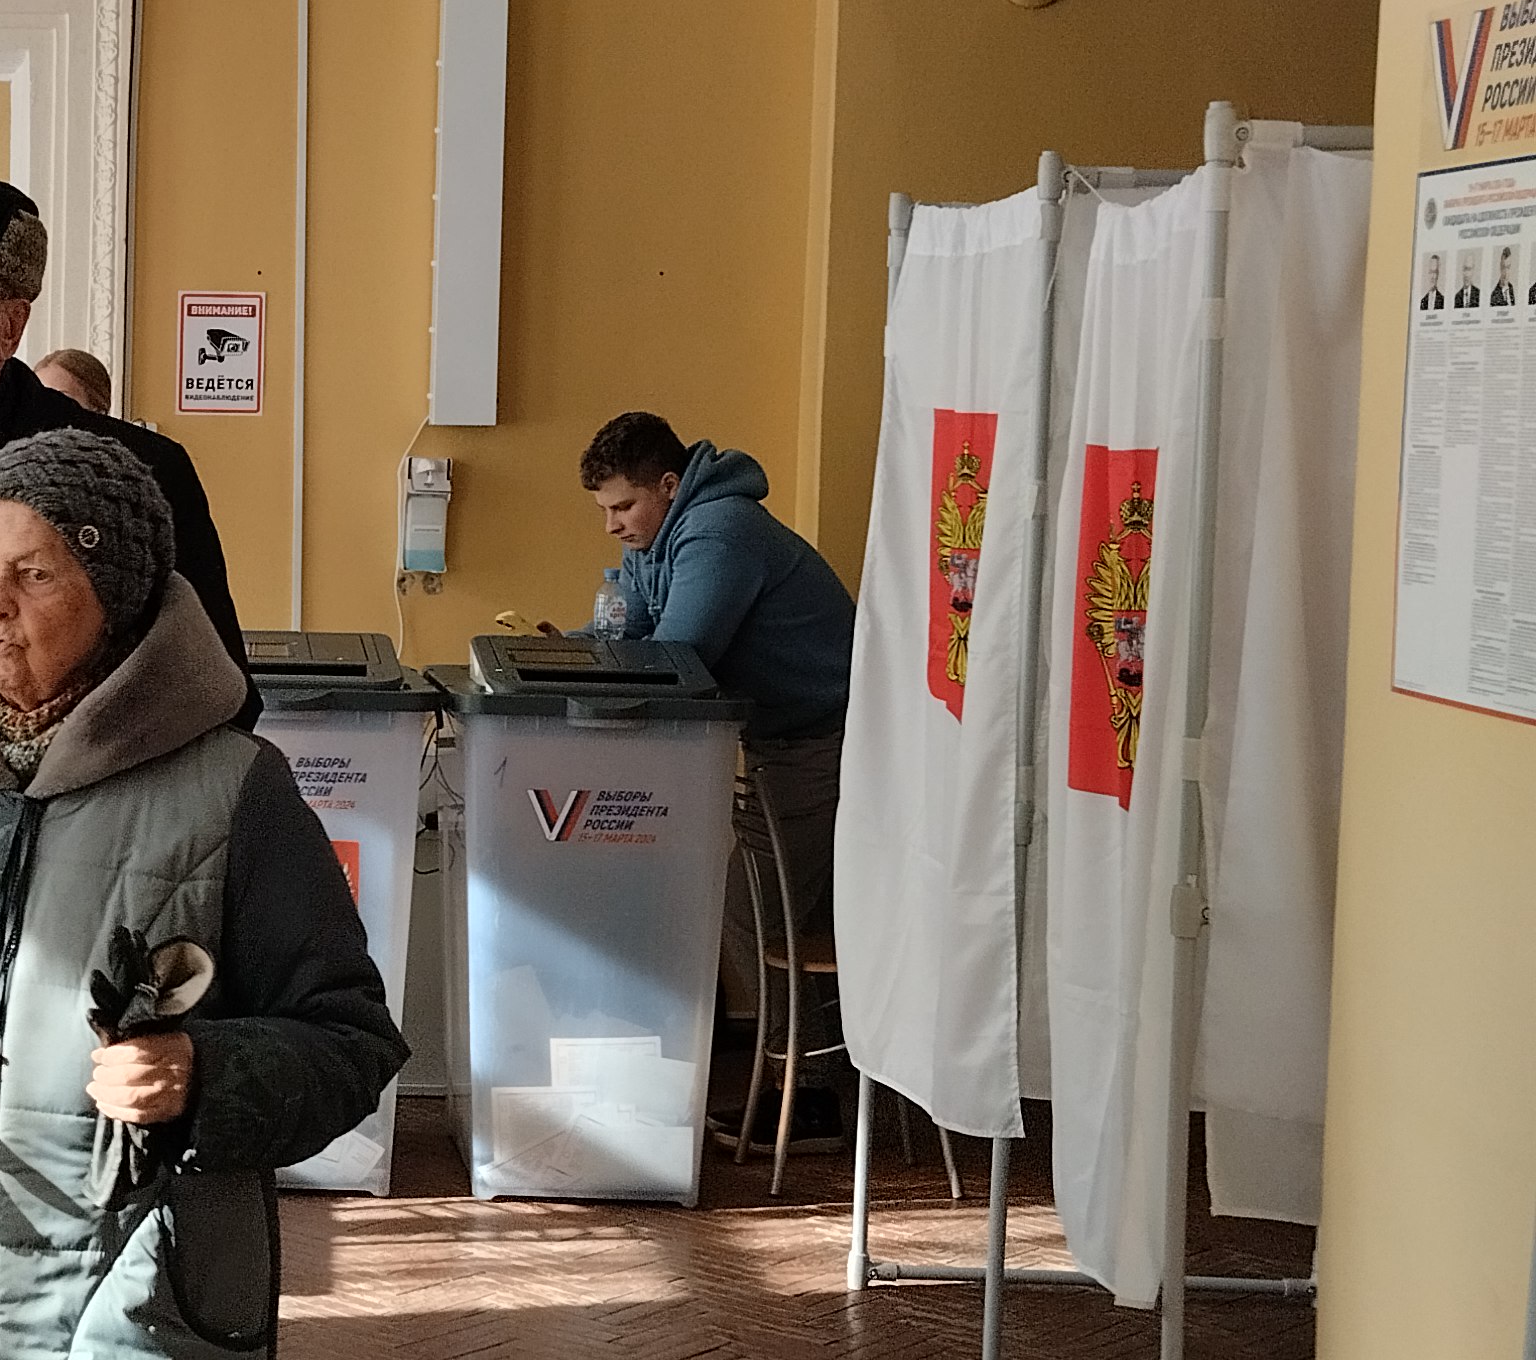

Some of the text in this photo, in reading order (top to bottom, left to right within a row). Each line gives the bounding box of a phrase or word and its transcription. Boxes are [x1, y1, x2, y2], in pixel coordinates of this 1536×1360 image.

[190, 305, 253, 316] ВНИМАНИЕ!
[185, 375, 254, 392] ВЕДЁТСЯ
[184, 394, 254, 402] ВИДЕОНАБЛЮДЕНИЕ
[295, 757, 352, 769] ВЫБОРЫ
[596, 790, 654, 802] ВЫБОРЫ
[590, 805, 669, 818] ПРЕЗИДЕНТА
[583, 819, 635, 831] РОССИИ
